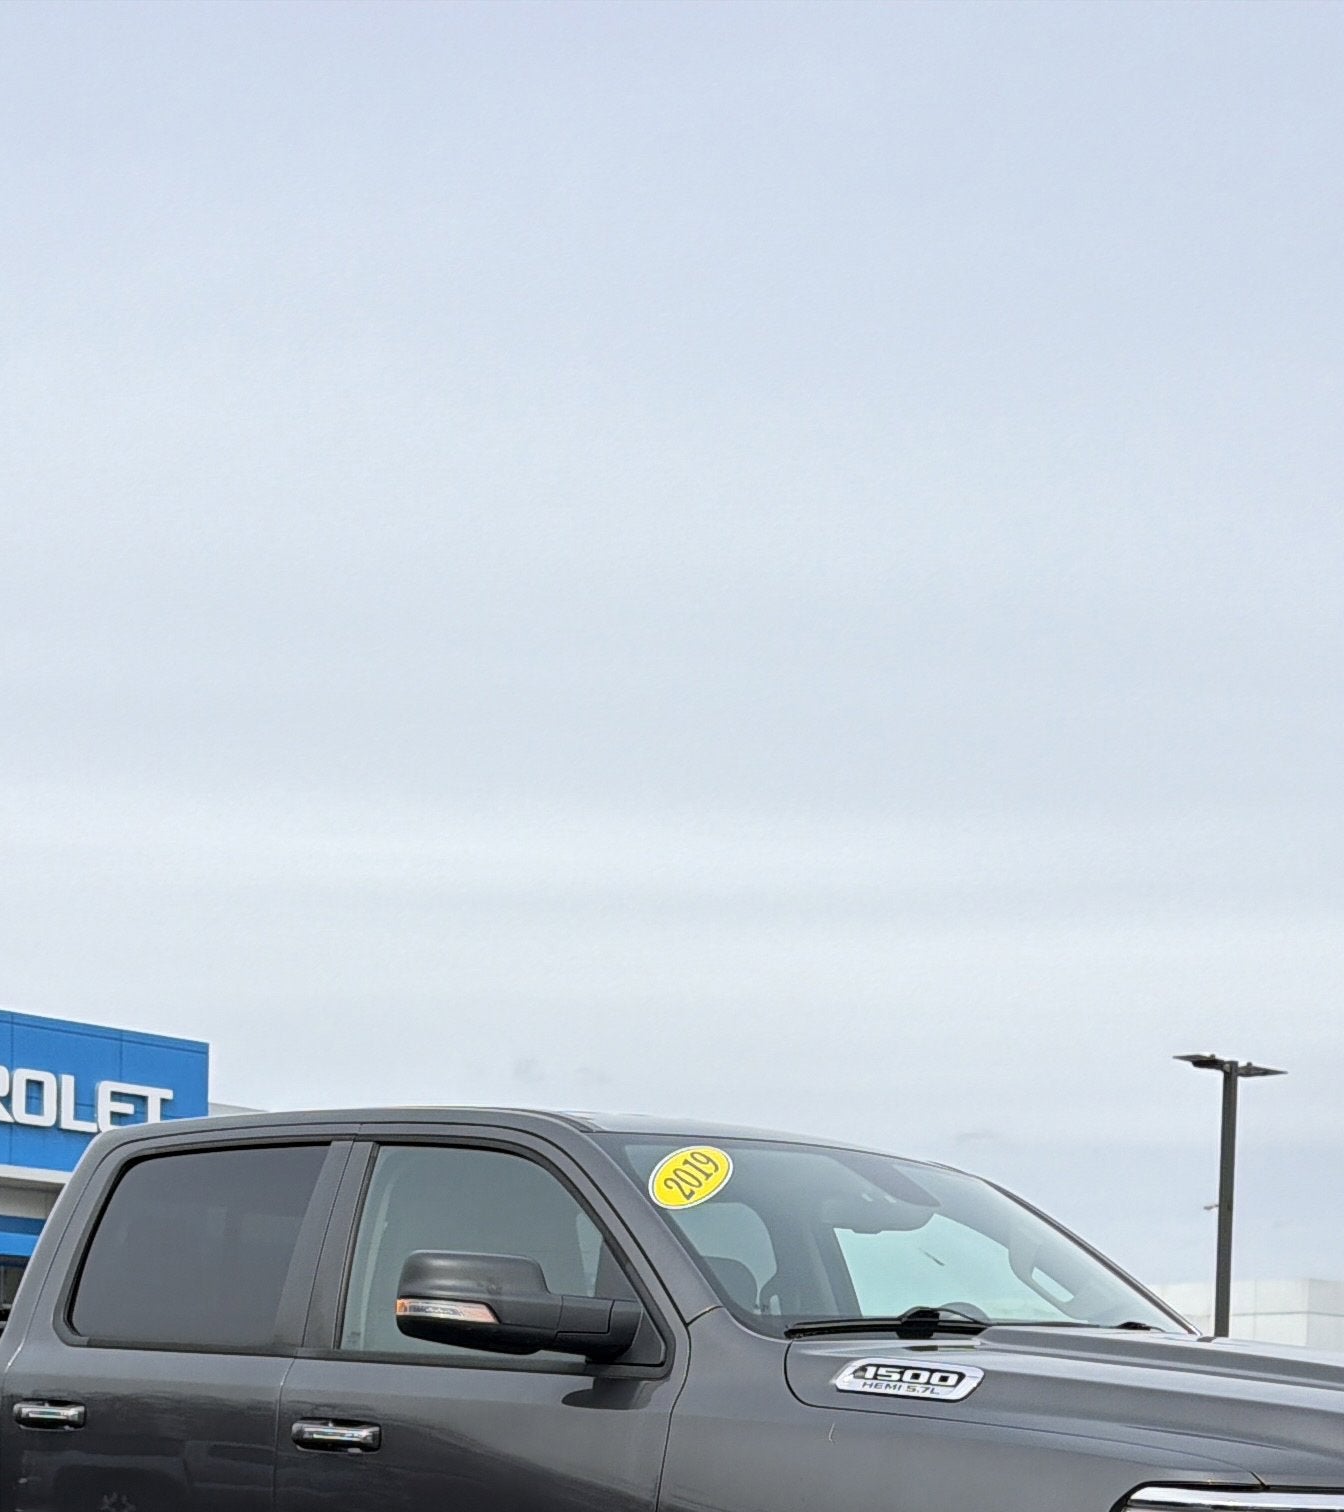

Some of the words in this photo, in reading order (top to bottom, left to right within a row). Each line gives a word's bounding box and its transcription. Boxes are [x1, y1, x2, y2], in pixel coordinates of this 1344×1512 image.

[663, 1151, 719, 1201] 2019
[863, 1365, 959, 1386] 1500
[861, 1381, 902, 1392] HEMI
[905, 1384, 940, 1396] 5.7L
